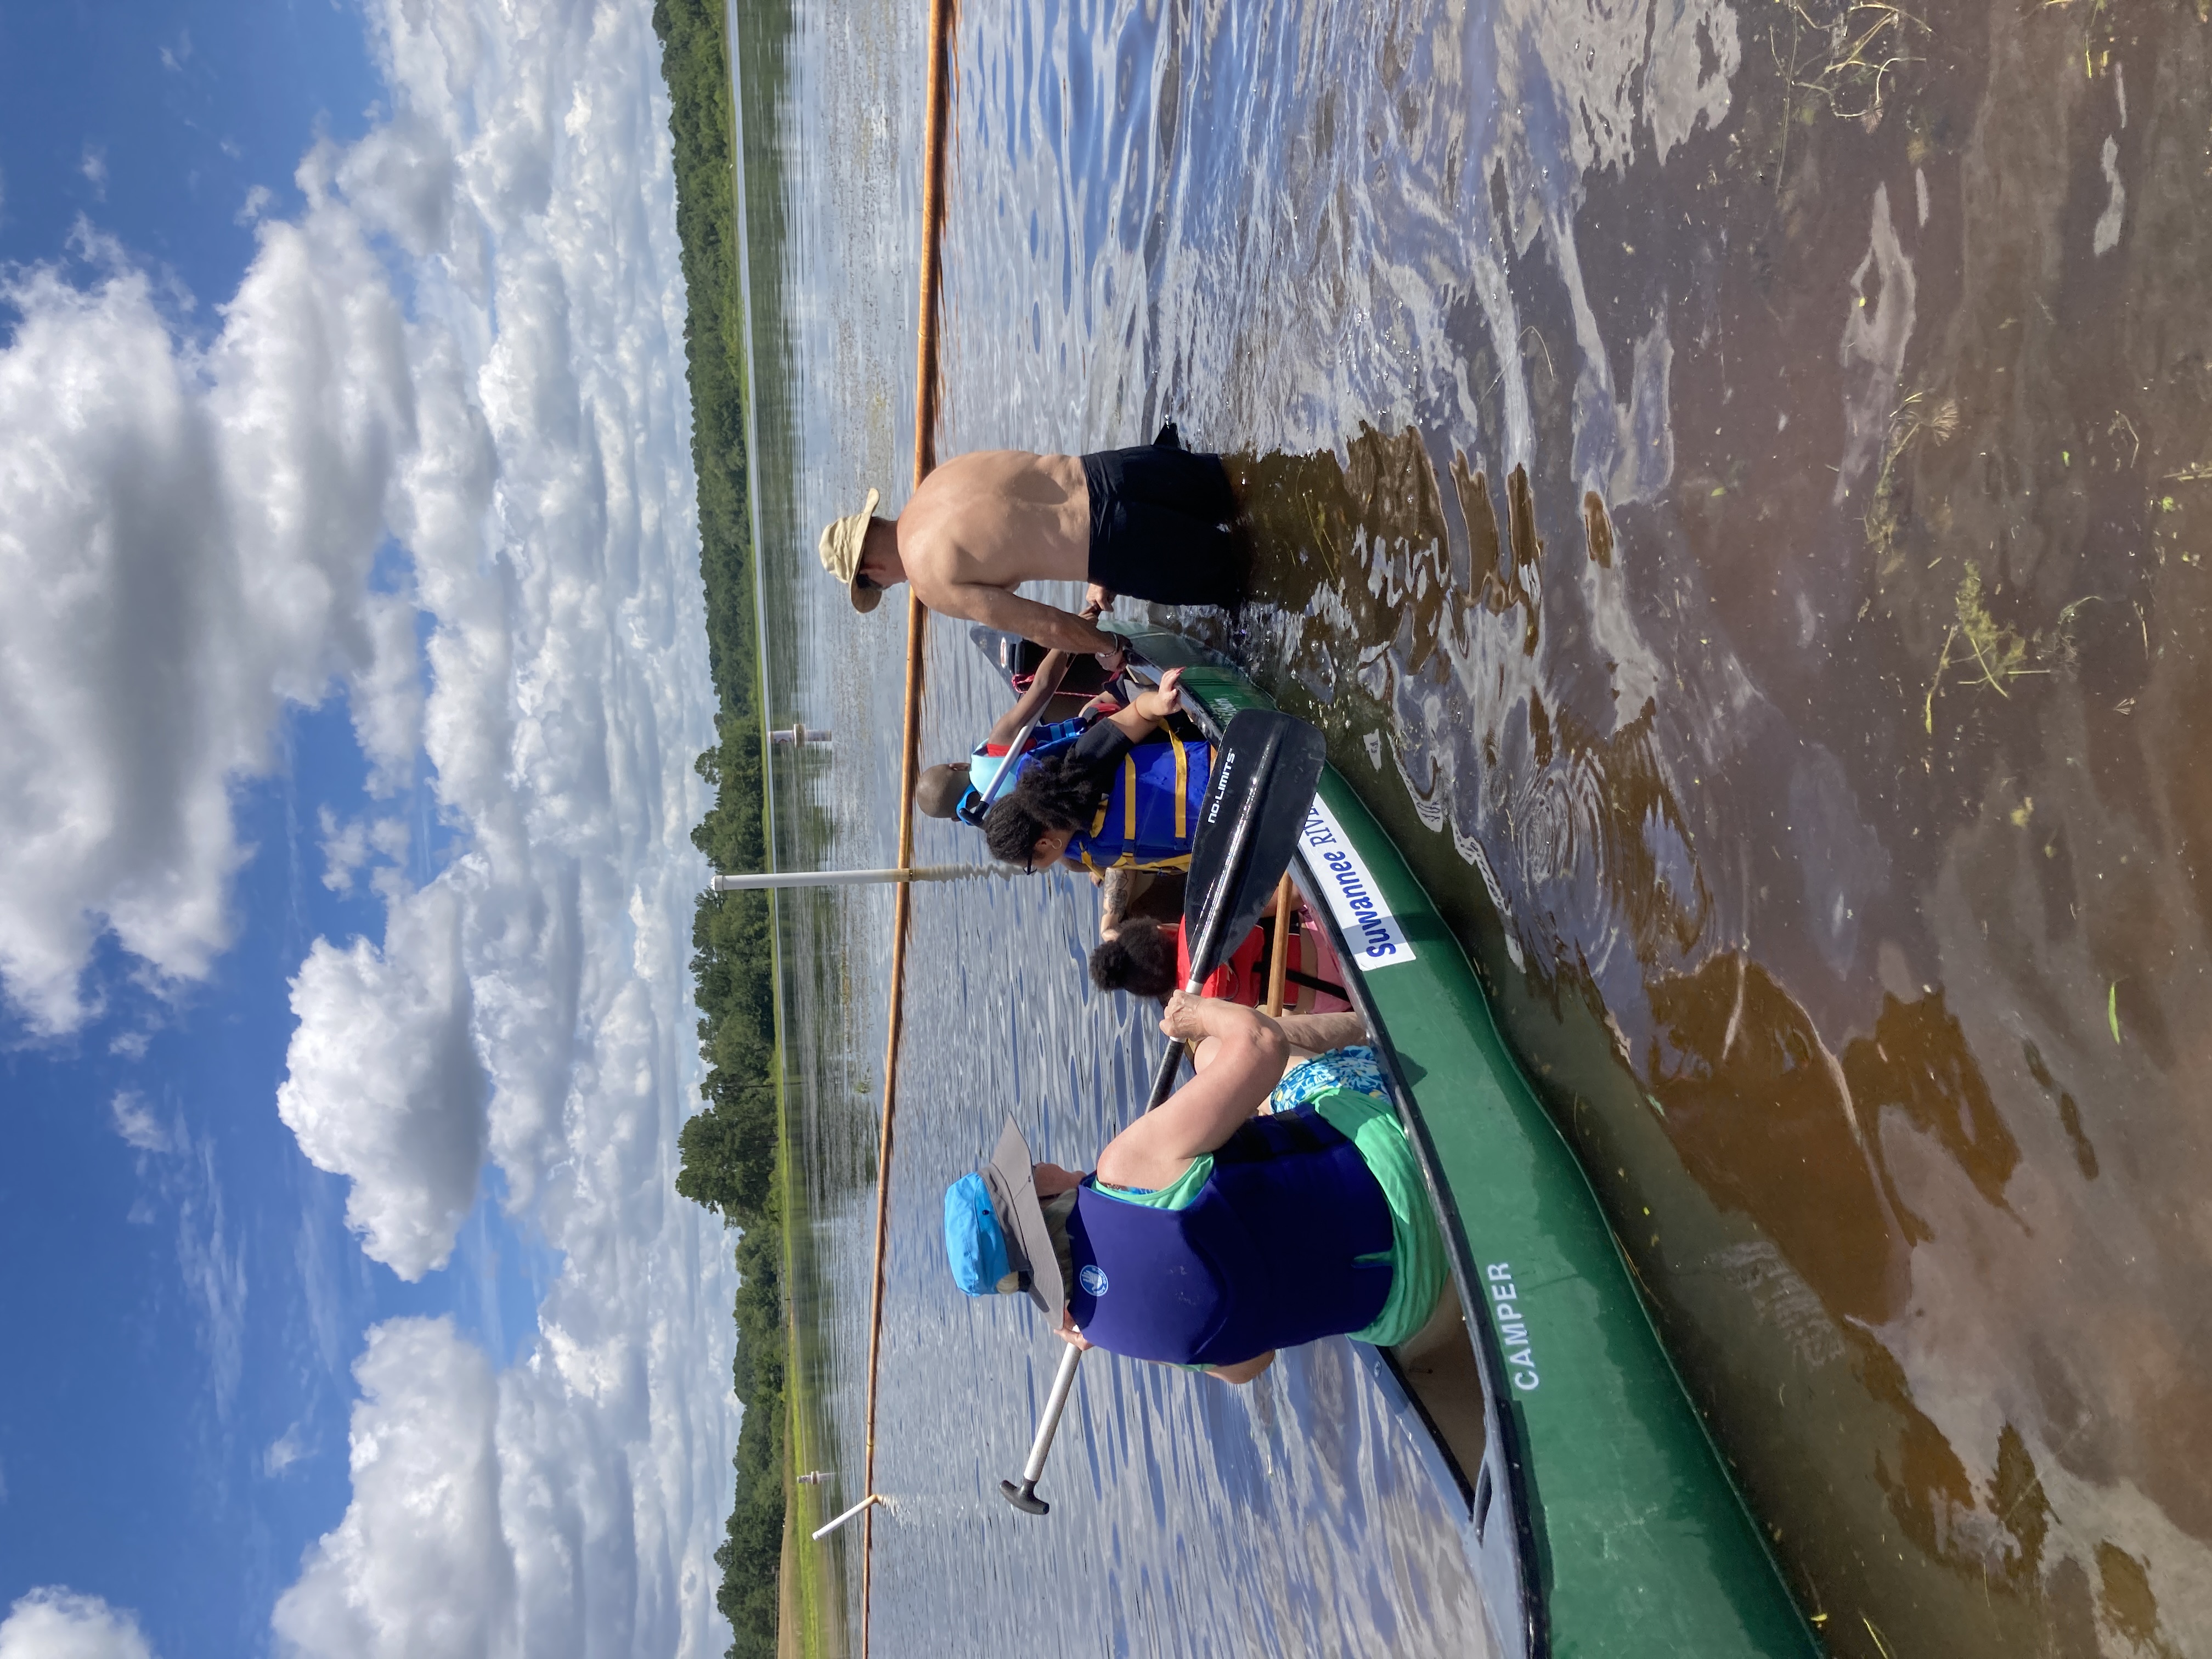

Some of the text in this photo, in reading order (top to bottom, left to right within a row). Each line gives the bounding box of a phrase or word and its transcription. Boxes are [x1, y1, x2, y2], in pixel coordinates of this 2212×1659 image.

[1304, 805, 1396, 957] Suwannee RIV
[1487, 1262, 1539, 1390] CAMPER
